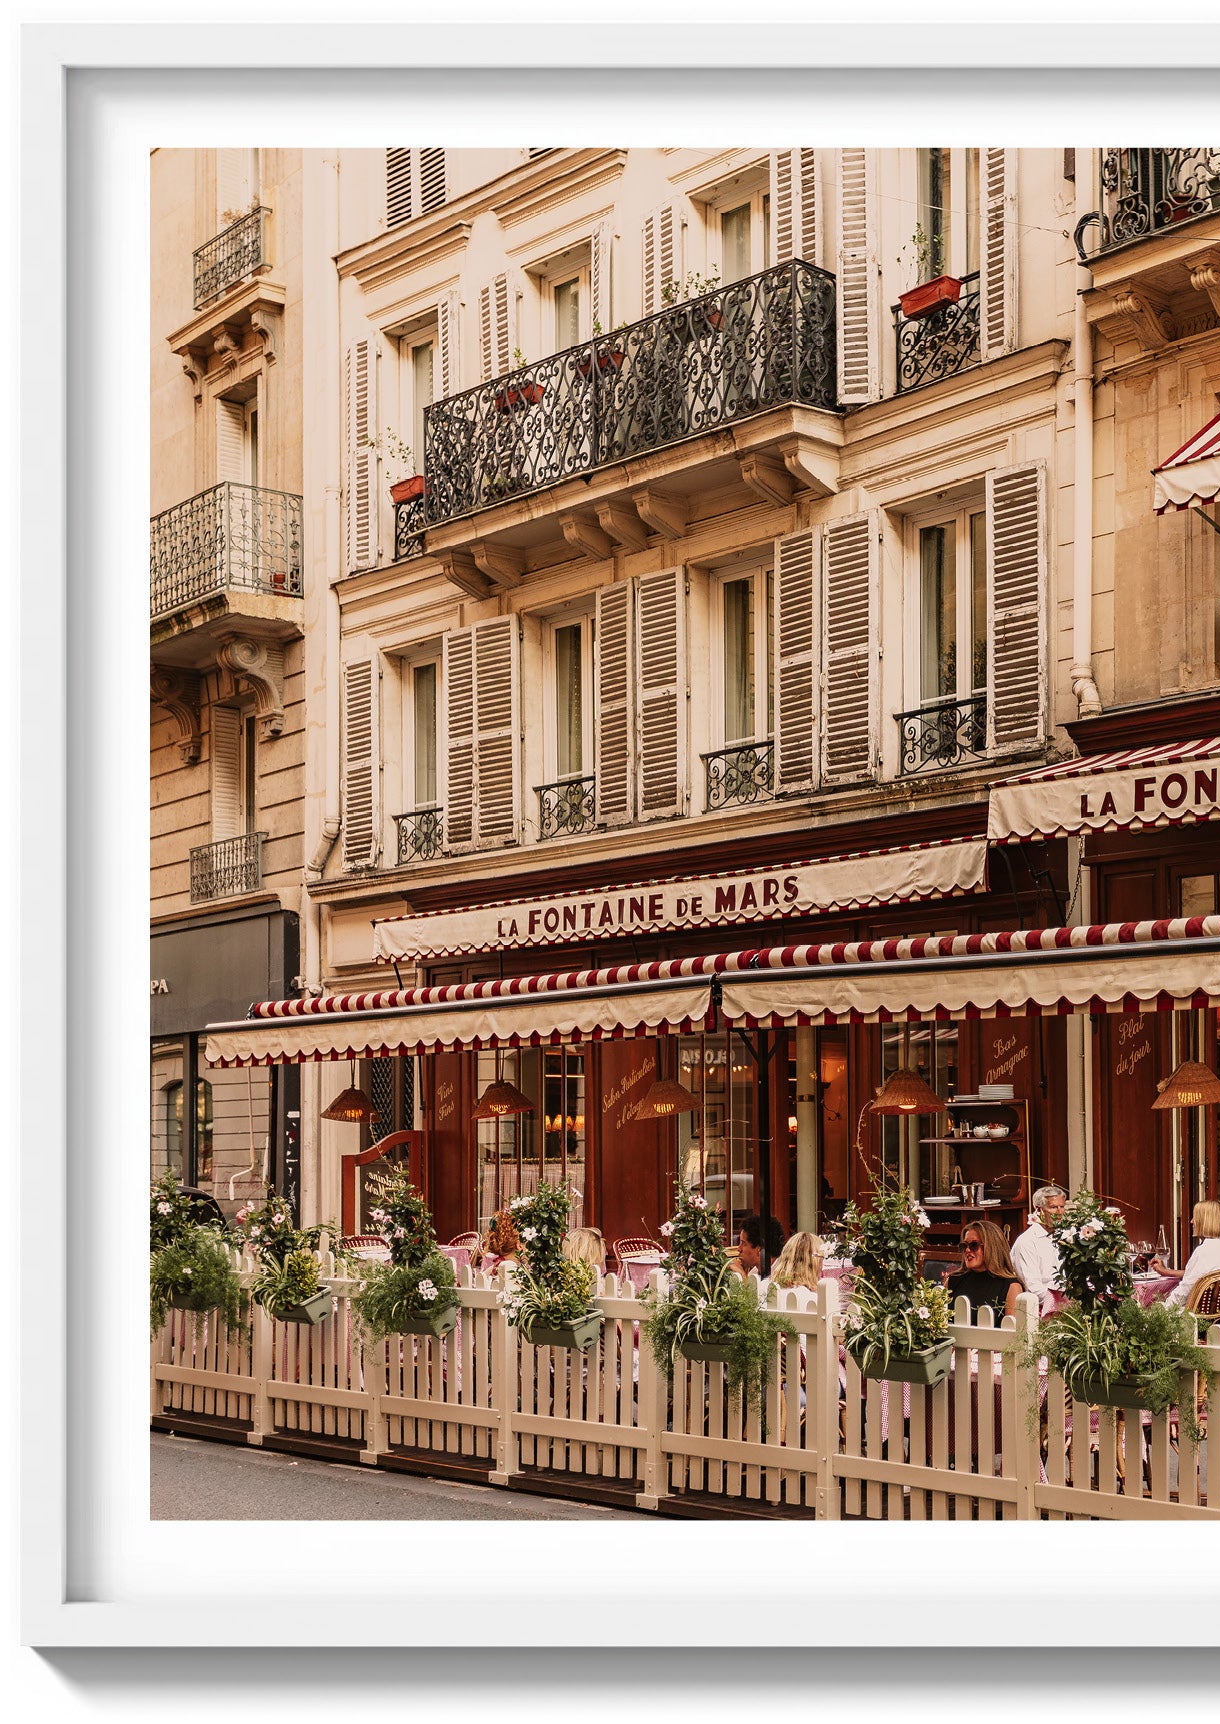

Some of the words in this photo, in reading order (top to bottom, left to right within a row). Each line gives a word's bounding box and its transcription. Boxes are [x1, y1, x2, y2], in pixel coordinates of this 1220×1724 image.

[1080, 791, 1117, 818] LA
[497, 919, 519, 938] LA
[528, 893, 664, 935] FONTAINE
[676, 896, 702, 918] DE
[714, 875, 799, 914] MARS
[1118, 1011, 1146, 1046] Plat
[992, 1034, 1016, 1059] Bas
[1116, 1053, 1129, 1076] du
[1128, 1040, 1152, 1075] jour
